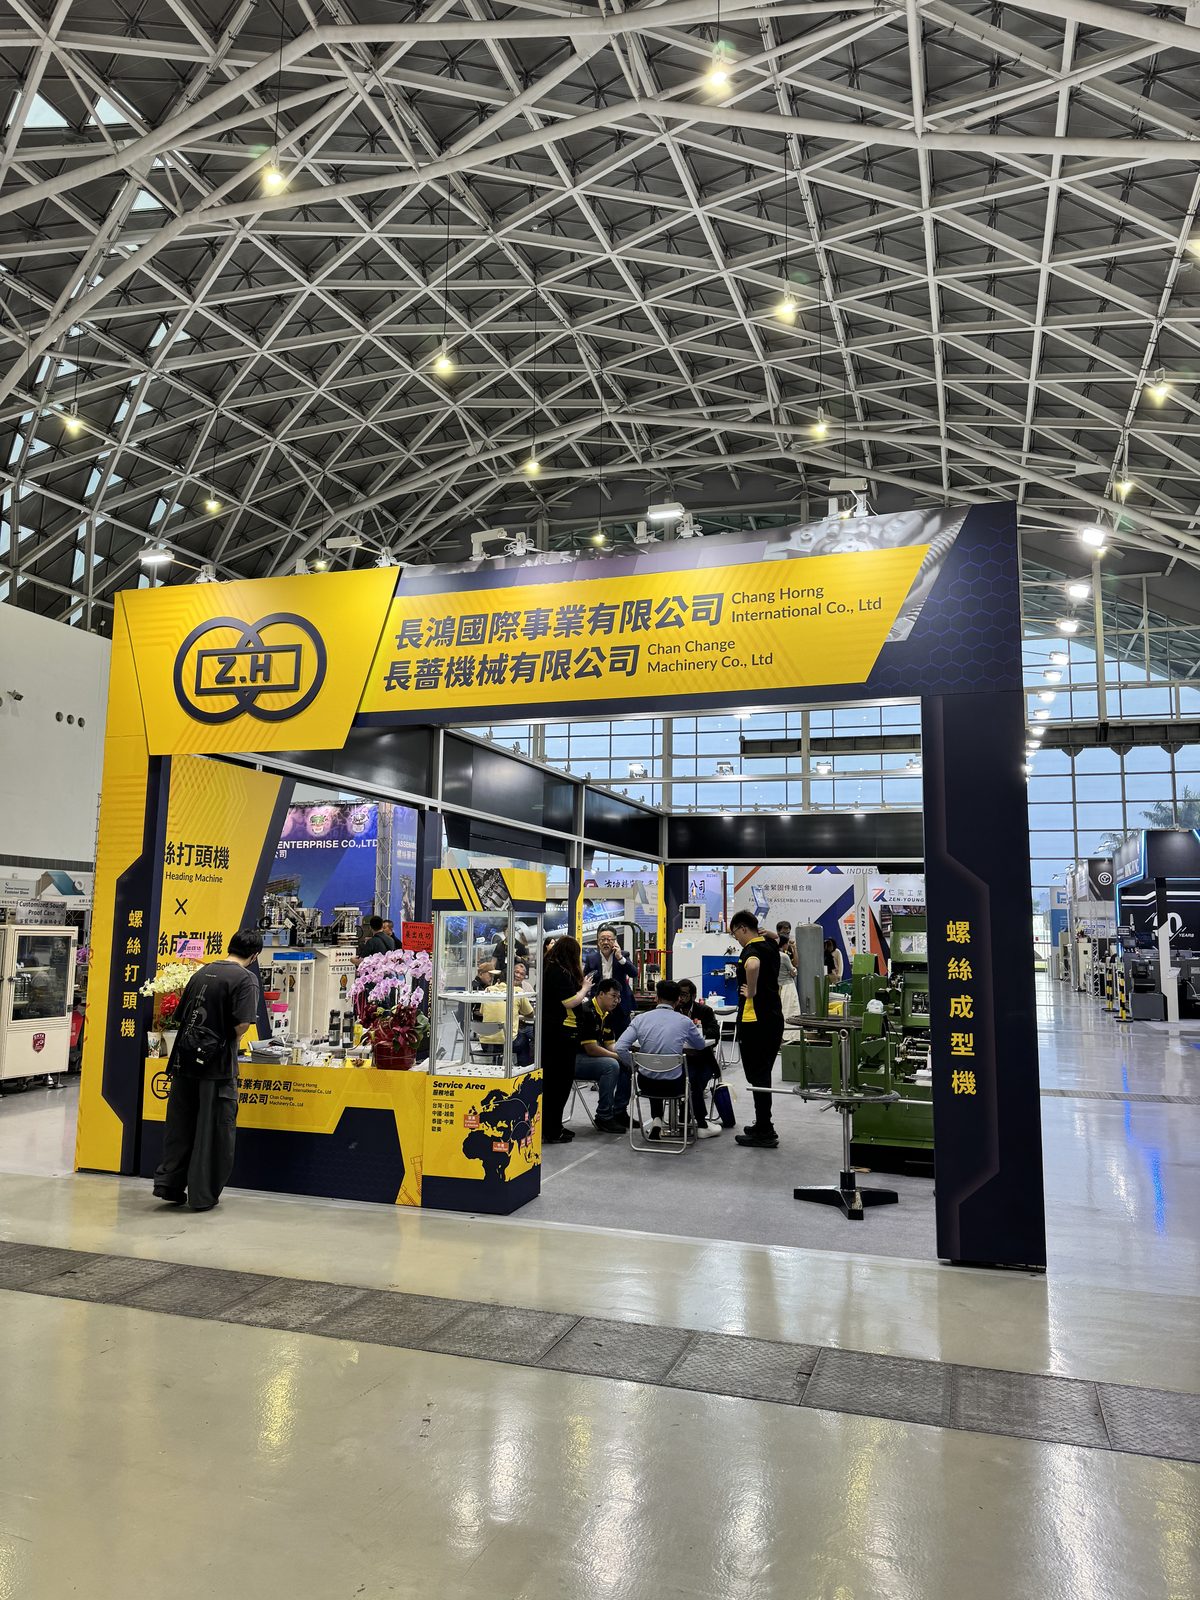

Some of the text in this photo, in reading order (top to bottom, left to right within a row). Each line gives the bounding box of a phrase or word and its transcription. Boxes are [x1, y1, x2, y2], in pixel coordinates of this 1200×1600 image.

[731, 586, 825, 605] Chang Horng
[395, 592, 725, 650] 長鴻國際事業有限公司
[731, 596, 882, 623] International Co., Ltd
[647, 639, 736, 656] Chan Change
[215, 653, 272, 684] Z.H
[383, 644, 641, 692] 長薔機械有限公司
[647, 652, 773, 673] Machinery Co., Ltd
[277, 840, 339, 849] ENTERPRISE
[165, 871, 223, 884] Heading Machine
[119, 909, 144, 1039] 螺絲打頭機
[945, 920, 977, 1096] 螺絲成型機
[432, 1080, 486, 1091] Service Area
